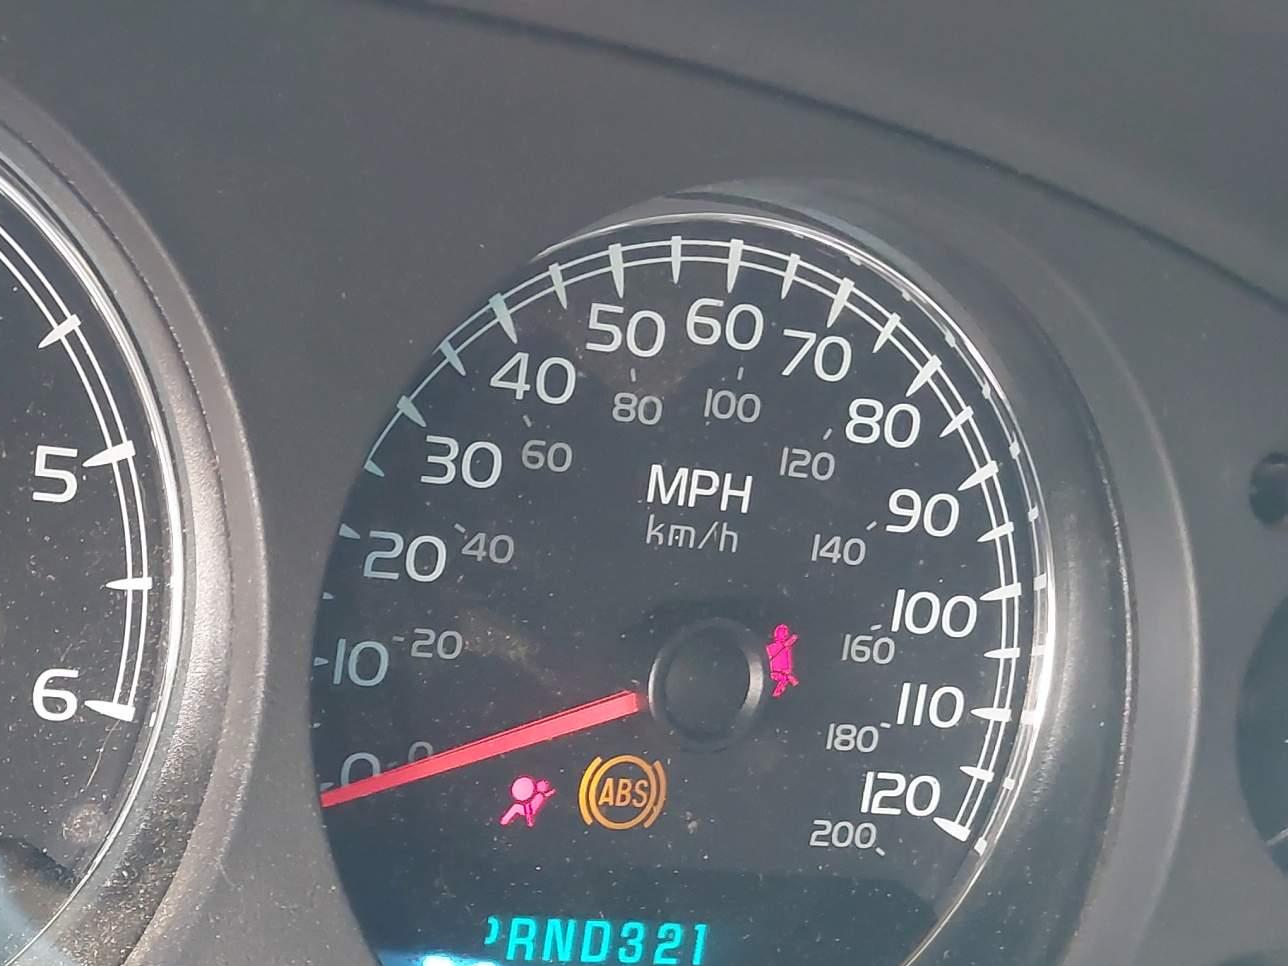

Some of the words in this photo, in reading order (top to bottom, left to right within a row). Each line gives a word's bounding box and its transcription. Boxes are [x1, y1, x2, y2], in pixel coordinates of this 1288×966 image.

[585, 302, 666, 357] 50
[685, 297, 765, 350] 60
[490, 351, 576, 405] 40
[781, 328, 852, 382] 70
[612, 392, 663, 425] 80
[703, 388, 761, 422] 100
[845, 398, 921, 448] 80
[32, 444, 79, 503] 5
[420, 433, 502, 489] 30
[521, 439, 573, 473] 60
[779, 447, 835, 481] 120
[646, 464, 753, 514] MPH
[885, 488, 960, 537] 90
[364, 529, 447, 583] 20
[462, 533, 514, 563] 40
[645, 514, 739, 553] km/h
[811, 534, 865, 566] 140
[890, 589, 977, 638] 100
[333, 638, 389, 687] 10
[411, 628, 463, 660] 20
[841, 633, 895, 664] 160
[32, 667, 80, 721] 6
[895, 682, 965, 729] 110
[826, 723, 878, 753] 180
[598, 777, 649, 809] ABS
[860, 770, 941, 817] 120
[809, 819, 877, 848] 200
